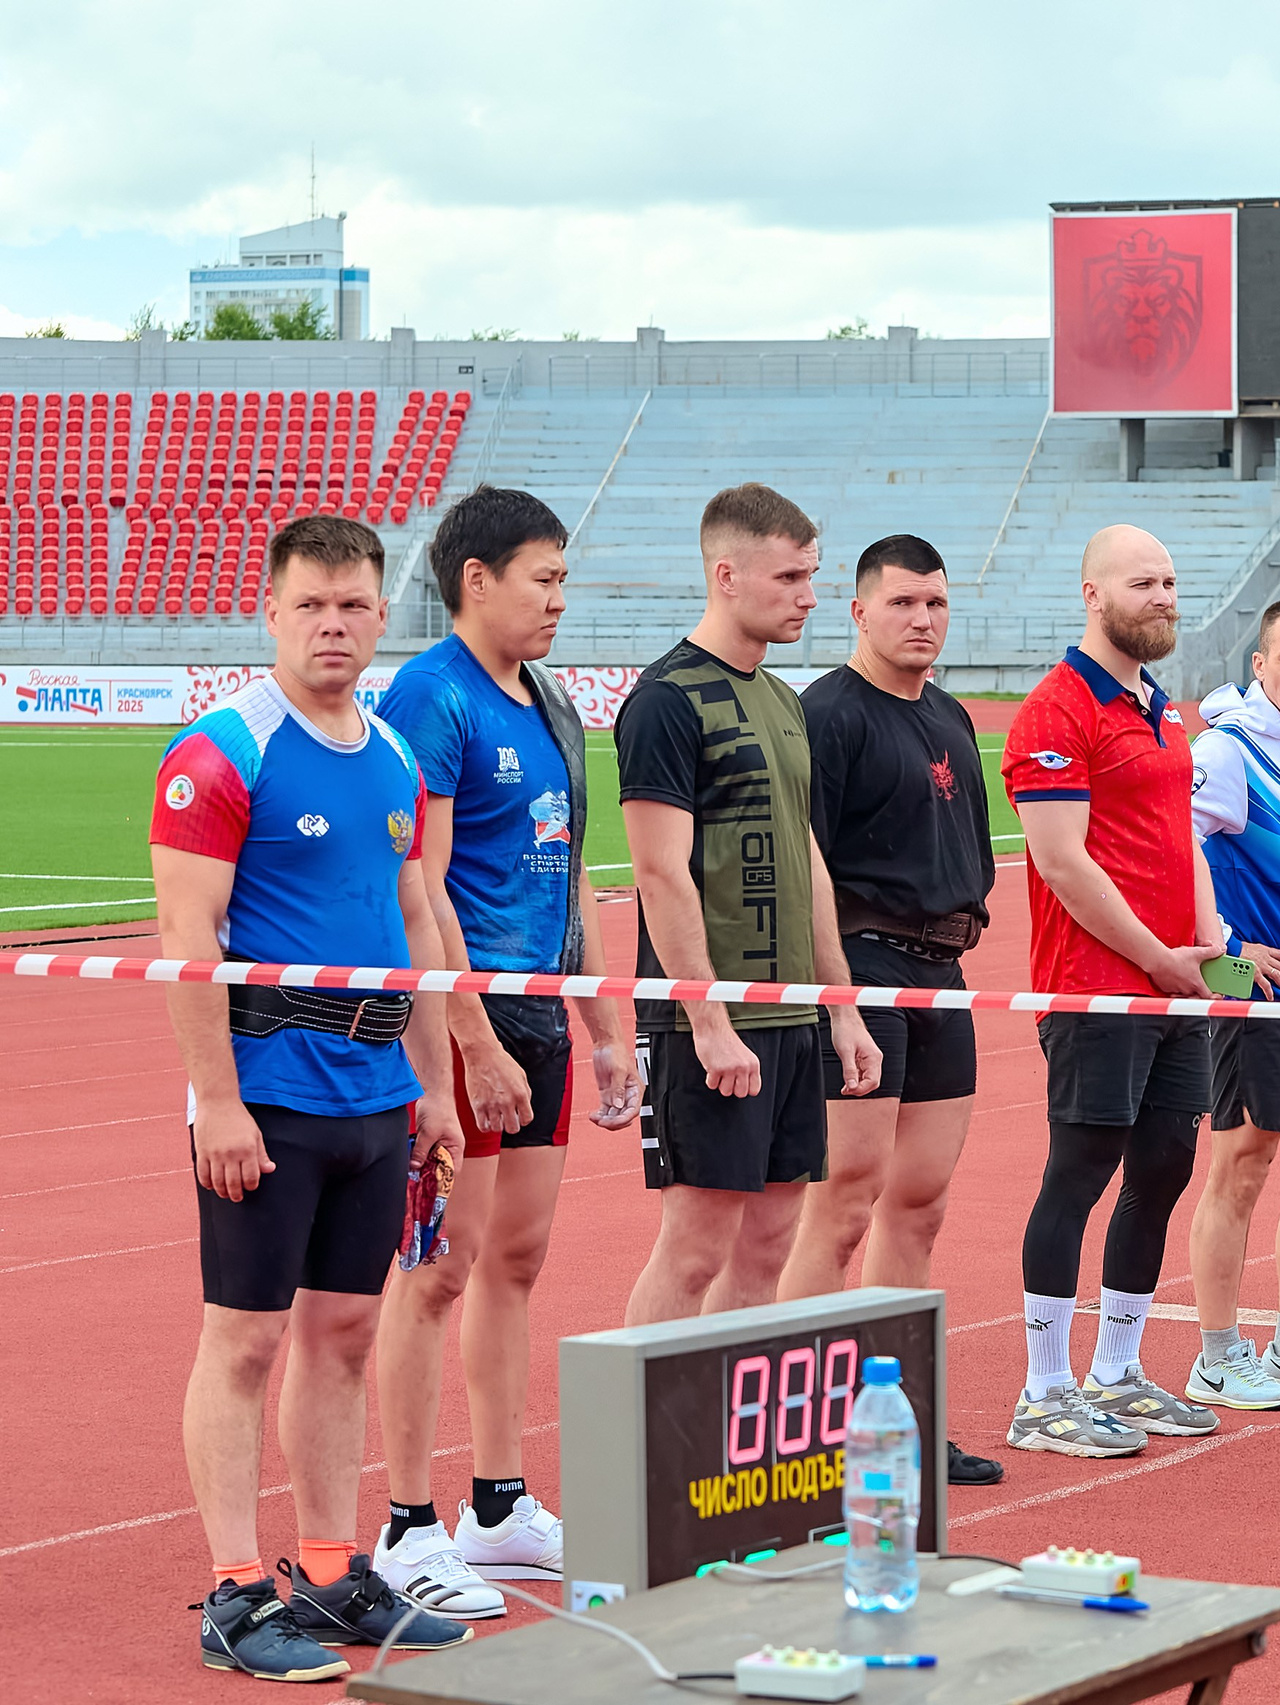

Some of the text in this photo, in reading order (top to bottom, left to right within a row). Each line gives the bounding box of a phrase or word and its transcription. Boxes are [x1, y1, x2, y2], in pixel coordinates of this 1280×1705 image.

[27, 669, 80, 685] Русская
[117, 689, 173, 698] КРАСНОЯРСК
[34, 688, 103, 712] ЛАПТА
[117, 700, 143, 712] 2025
[1107, 1315, 1133, 1326] PUMA
[1040, 1413, 1062, 1424] Reebok
[494, 1481, 524, 1493] PUMA
[688, 1466, 768, 1520] ЧИСЛО
